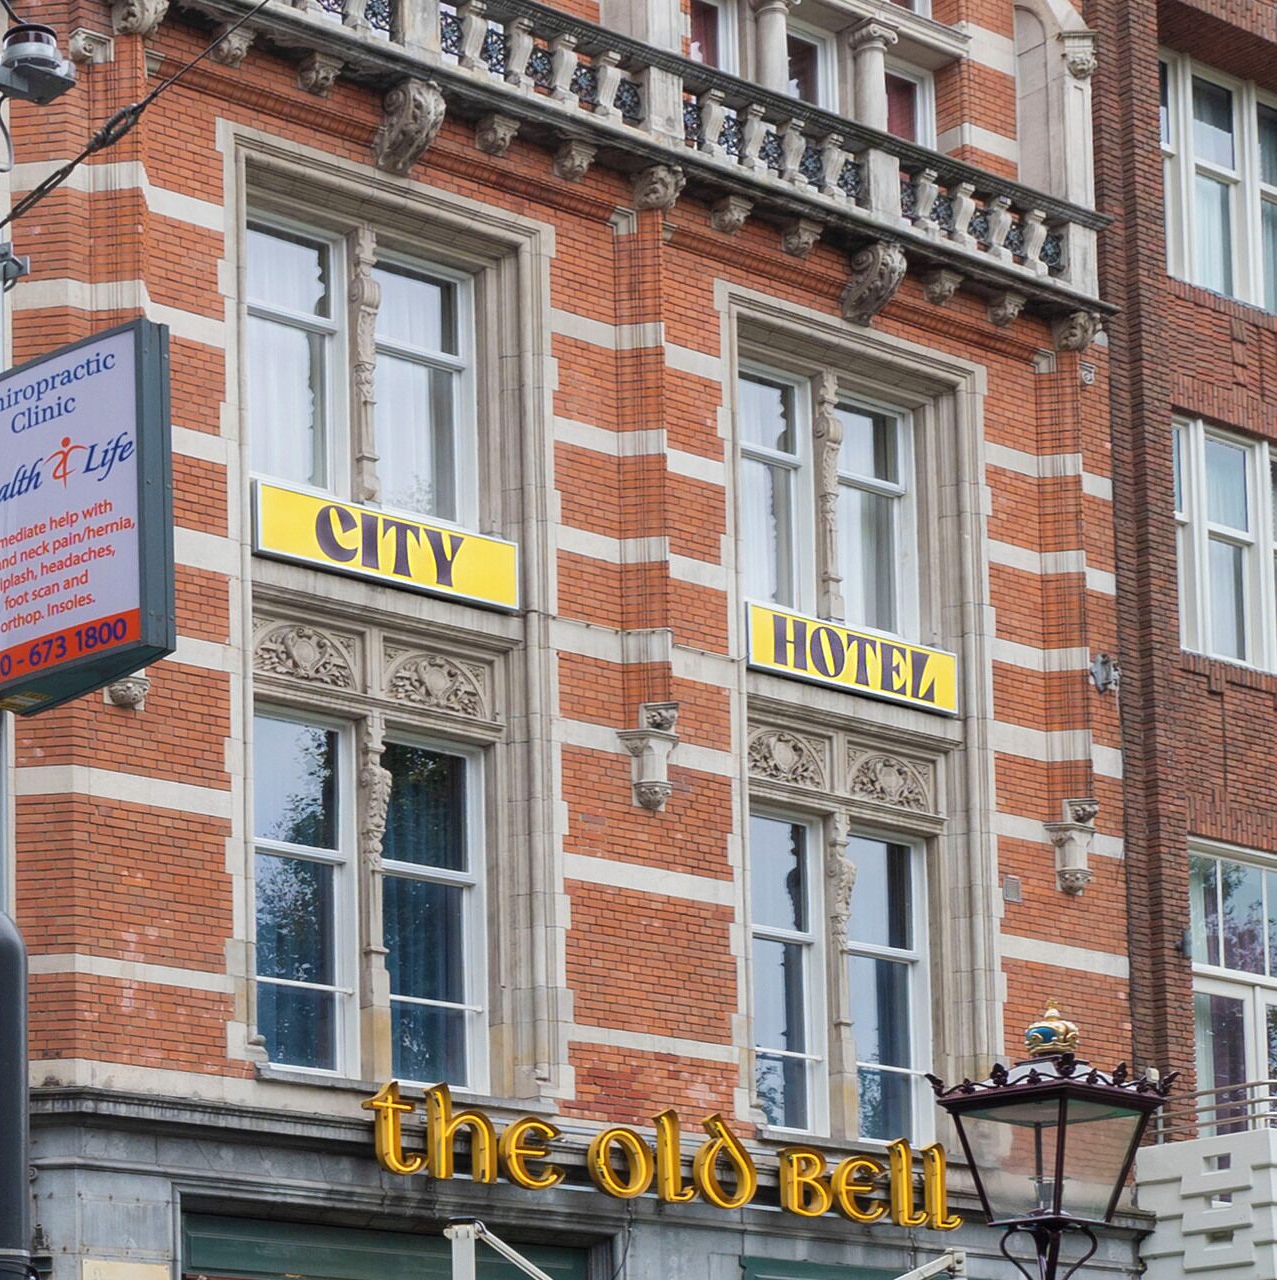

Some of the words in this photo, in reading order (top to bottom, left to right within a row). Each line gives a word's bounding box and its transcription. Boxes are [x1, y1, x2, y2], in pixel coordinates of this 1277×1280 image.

[11, 396, 76, 434] Clinic
[83, 431, 134, 481] Life
[49, 511, 78, 533] help
[81, 499, 113, 522] with
[20, 544, 50, 566] neck
[52, 518, 135, 555] pain/hernia,
[40, 546, 116, 580] headaches,
[315, 504, 465, 587] CITY
[4, 589, 29, 610] foot
[32, 582, 60, 602] scan
[63, 569, 89, 592] and
[0, 611, 45, 636] orthop.
[47, 594, 95, 619] Insoles.
[29, 635, 67, 667] 673
[76, 618, 127, 654] 1800
[772, 613, 937, 704] HOTEL
